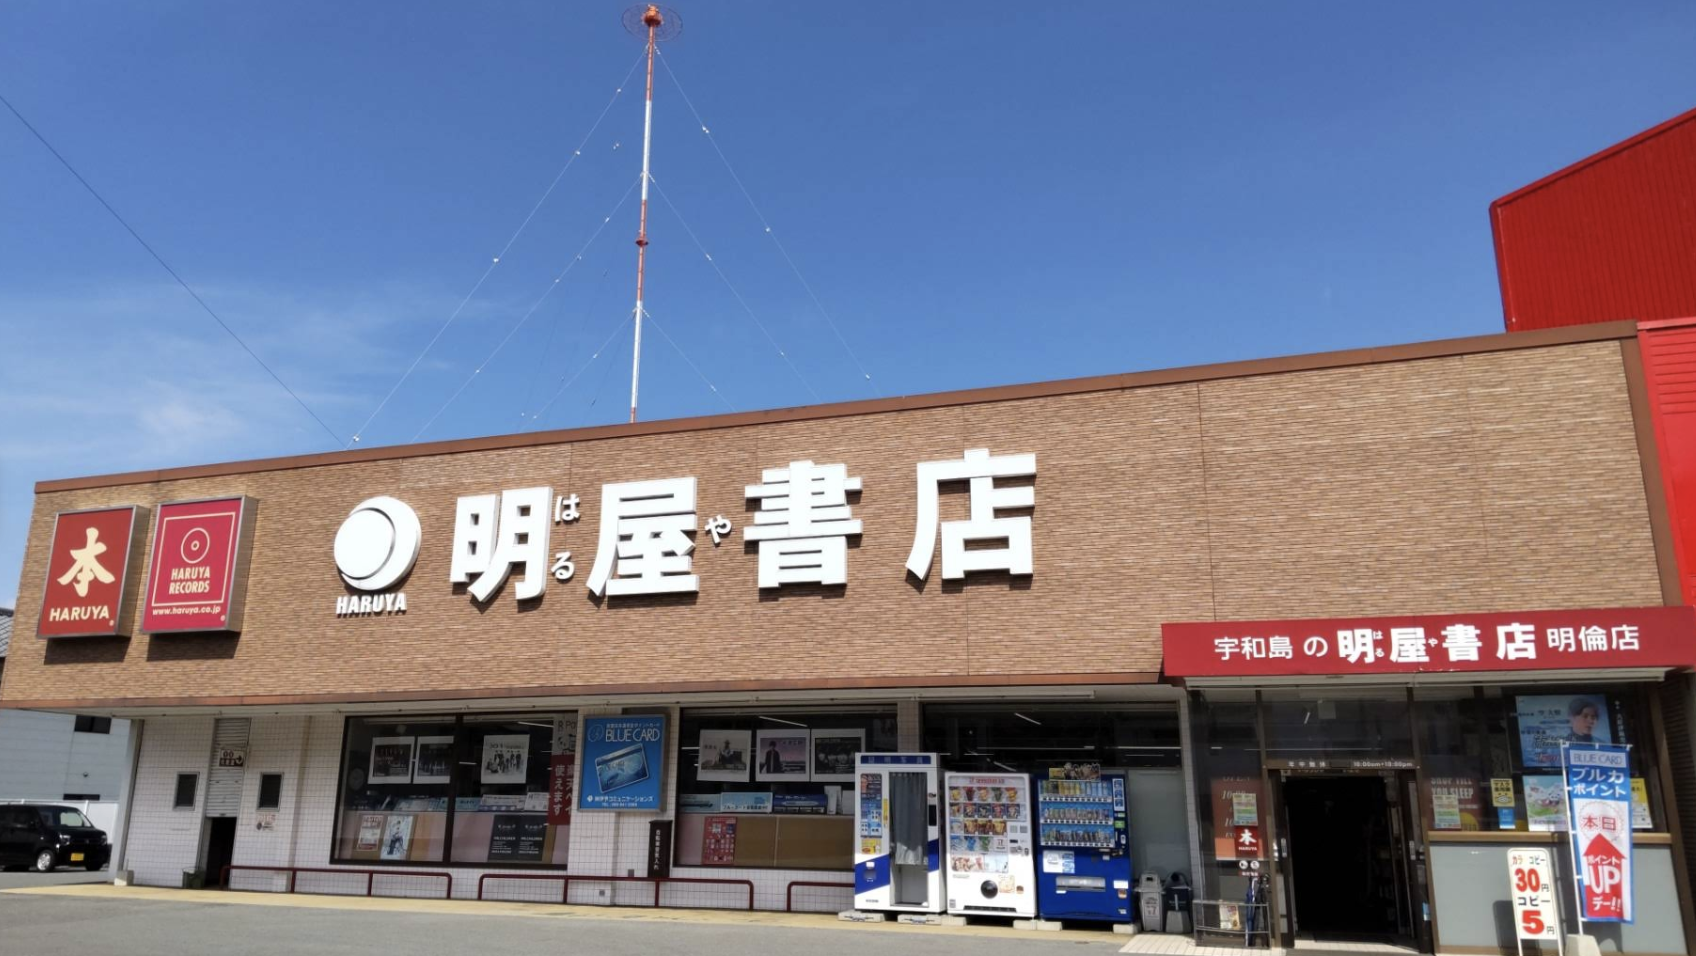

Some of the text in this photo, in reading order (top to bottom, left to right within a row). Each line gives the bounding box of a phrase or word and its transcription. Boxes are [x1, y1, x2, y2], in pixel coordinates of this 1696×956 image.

[704, 514, 732, 548] や
[57, 527, 116, 598] 本
[171, 566, 211, 580] HARUYA
[168, 580, 210, 595] RECORDS
[152, 606, 221, 616] www.haruya.co.jp
[336, 592, 408, 616] HARUYA
[49, 604, 110, 622] HARUYA
[1213, 635, 1294, 661] 宇和島
[1546, 624, 1640, 653] 明倫店
[606, 727, 661, 742] BLUE CARD
[1573, 753, 1597, 764] BLUE
[1598, 754, 1623, 766] CARD
[1572, 768, 1625, 785] ブルカ
[1573, 783, 1628, 798] ポイント
[1582, 815, 1617, 832] 本日
[1239, 829, 1257, 846] 本
[1587, 855, 1621, 865] ポイント
[1589, 865, 1621, 894] UP
